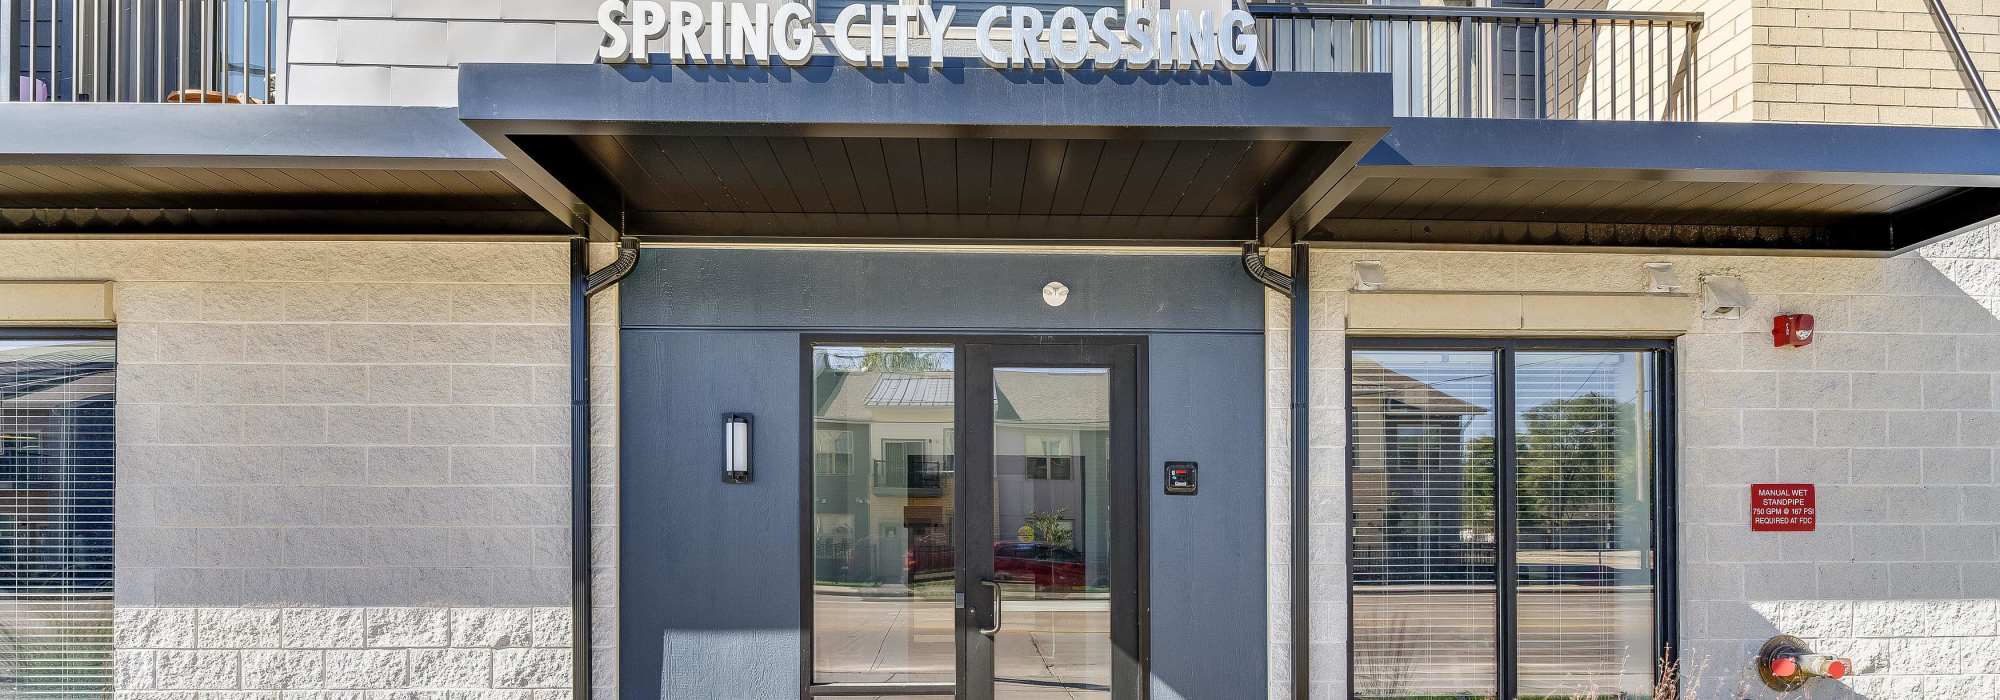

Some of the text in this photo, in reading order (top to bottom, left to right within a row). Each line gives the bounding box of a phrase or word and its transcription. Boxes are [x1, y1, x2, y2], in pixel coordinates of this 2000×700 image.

[598, 0, 1257, 70] SPRING CITY CROSSING
